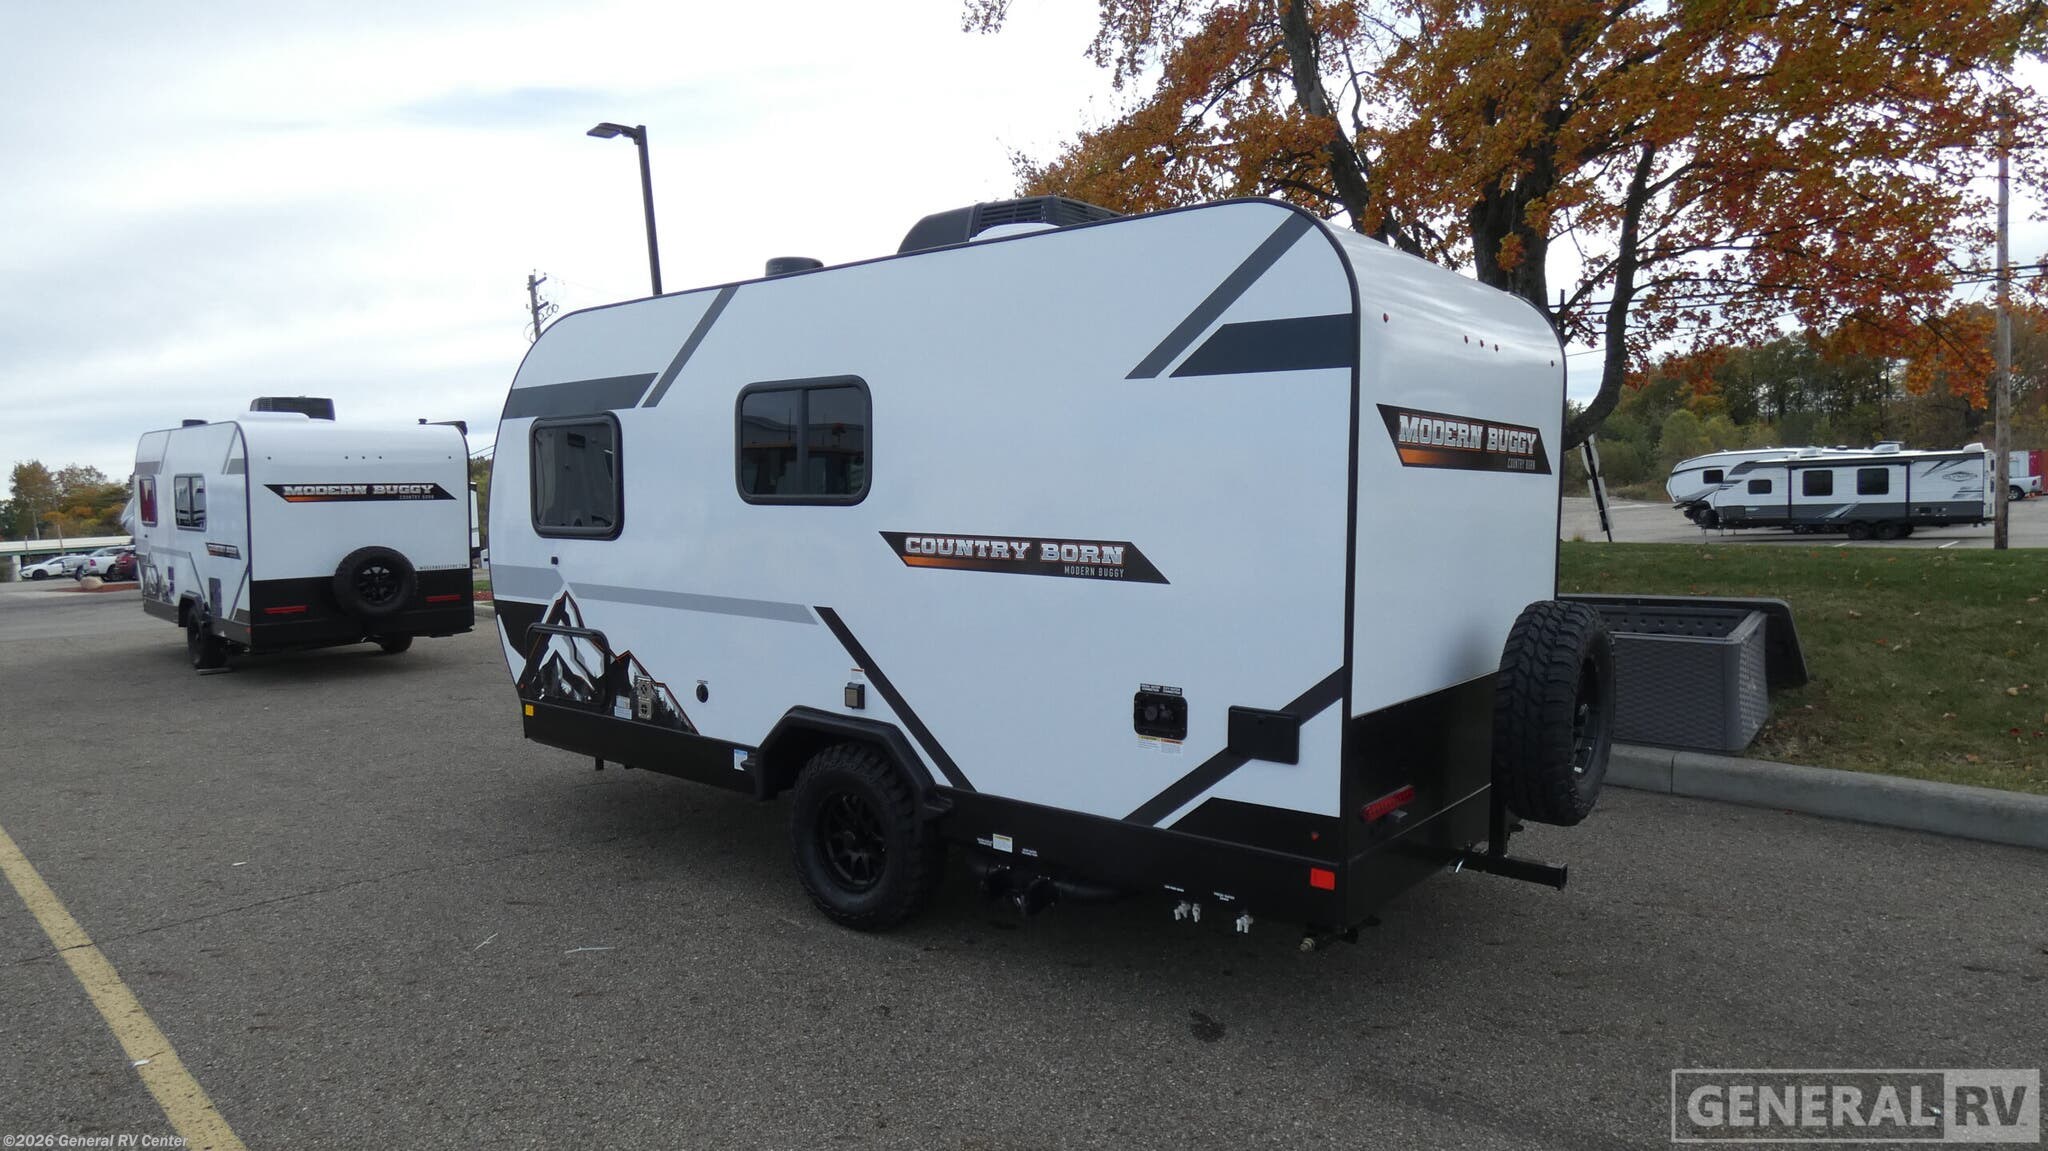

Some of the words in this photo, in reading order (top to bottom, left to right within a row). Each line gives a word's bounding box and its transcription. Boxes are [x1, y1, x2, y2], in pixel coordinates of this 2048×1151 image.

[1399, 414, 1484, 450] MODERN
[1487, 427, 1537, 455] BUGGY
[283, 485, 367, 496] MODERN
[372, 485, 434, 494] BUGGY
[905, 537, 1032, 559] COUNTRY
[1040, 543, 1125, 565] BORN
[1064, 565, 1095, 577] MODERN
[1098, 567, 1125, 579] BUGGY
